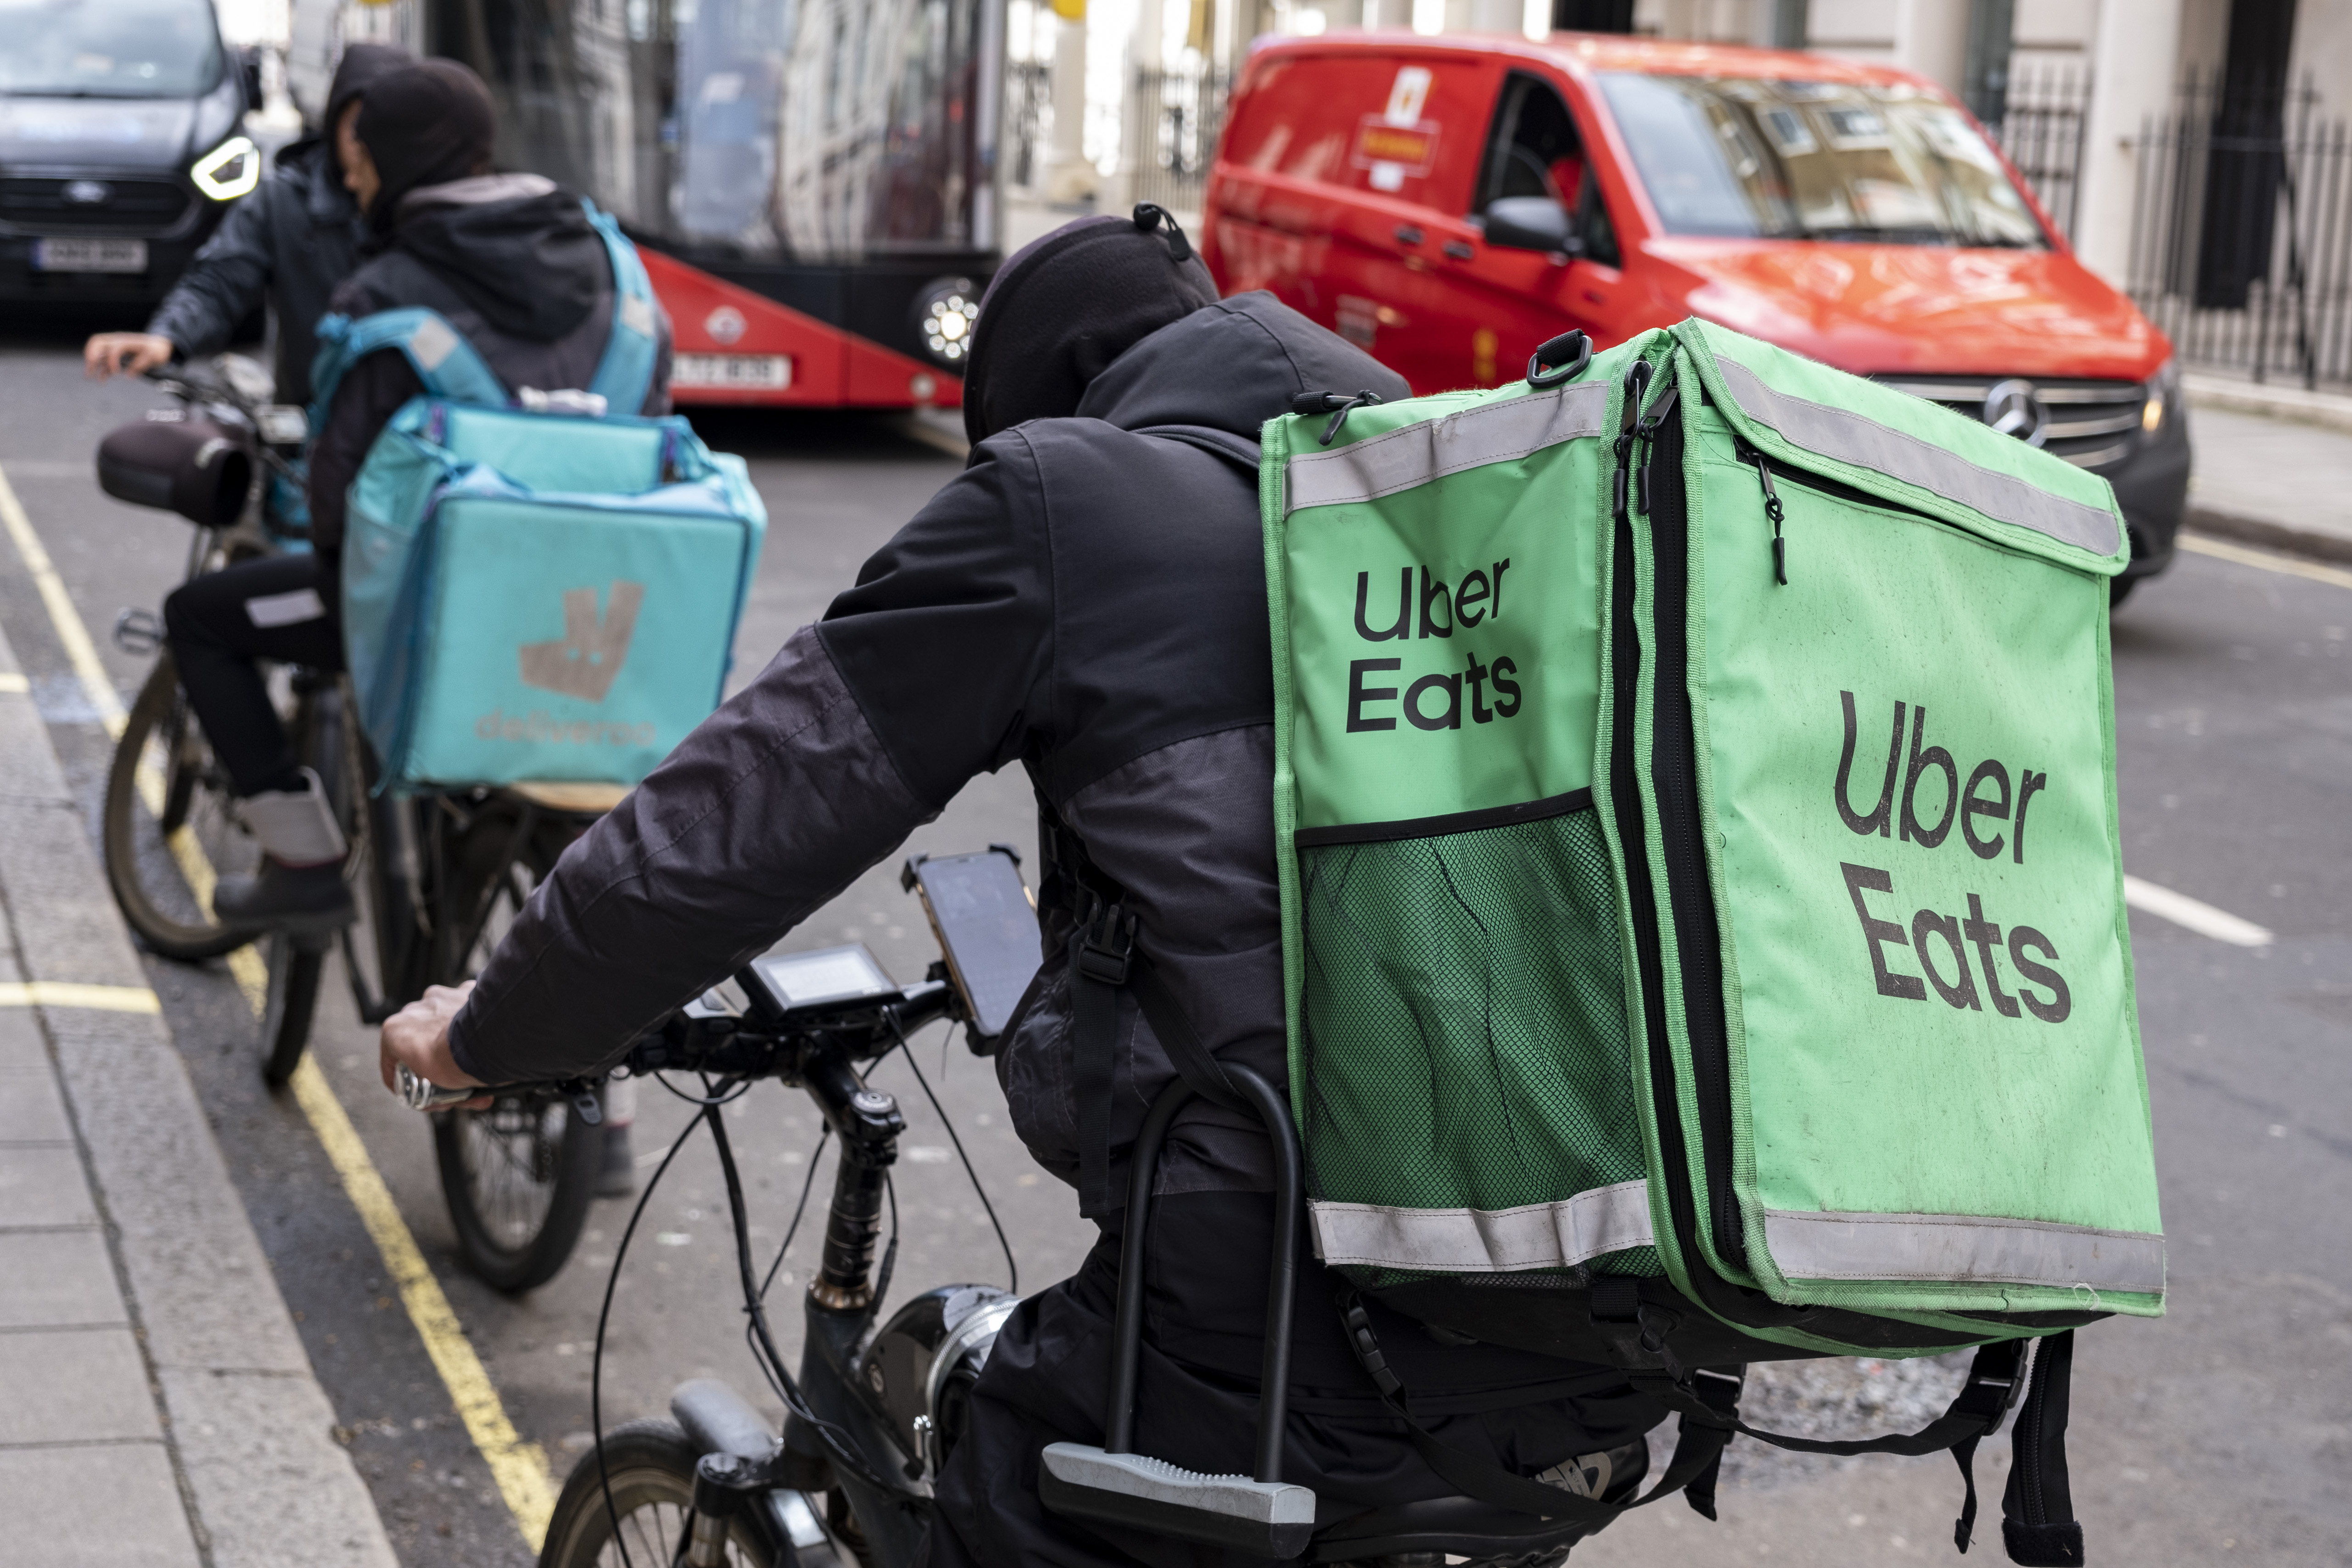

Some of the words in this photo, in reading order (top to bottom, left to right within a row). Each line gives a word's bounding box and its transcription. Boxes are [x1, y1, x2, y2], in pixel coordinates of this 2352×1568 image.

[1354, 557, 1510, 642] Uber
[1346, 651, 1522, 733] Eats
[1835, 690, 2047, 865] Uber
[1839, 861, 2071, 1023] Eats
